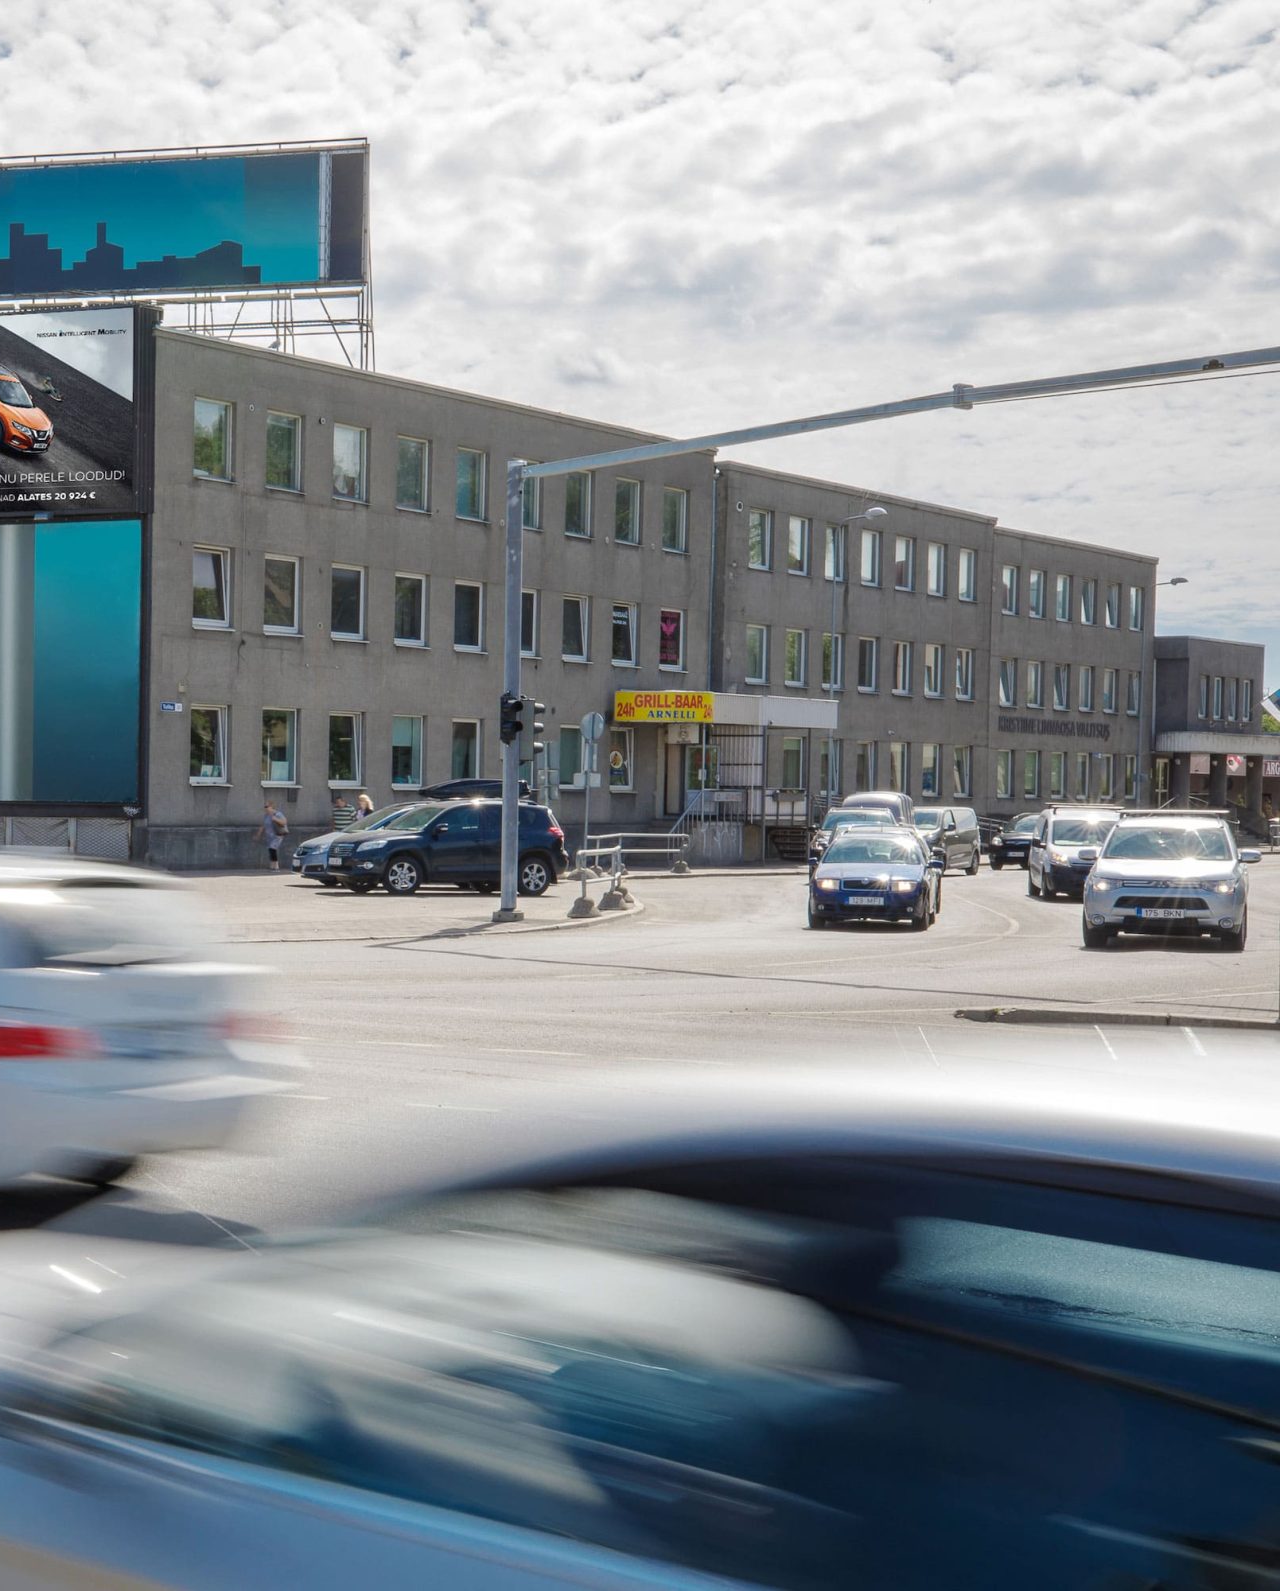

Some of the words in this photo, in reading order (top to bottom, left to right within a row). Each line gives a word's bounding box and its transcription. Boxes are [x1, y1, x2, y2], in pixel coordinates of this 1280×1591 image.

[19, 471, 66, 484] PERELE
[68, 470, 126, 482] LOODUD!
[17, 492, 53, 502] ALATES
[54, 492, 67, 500] 20
[68, 491, 87, 500] 924
[88, 491, 96, 499] €
[634, 694, 704, 709] GRILL-BAAR
[616, 702, 635, 718] 24h
[647, 710, 696, 720] ARNELLI
[1163, 909, 1183, 917] BKN
